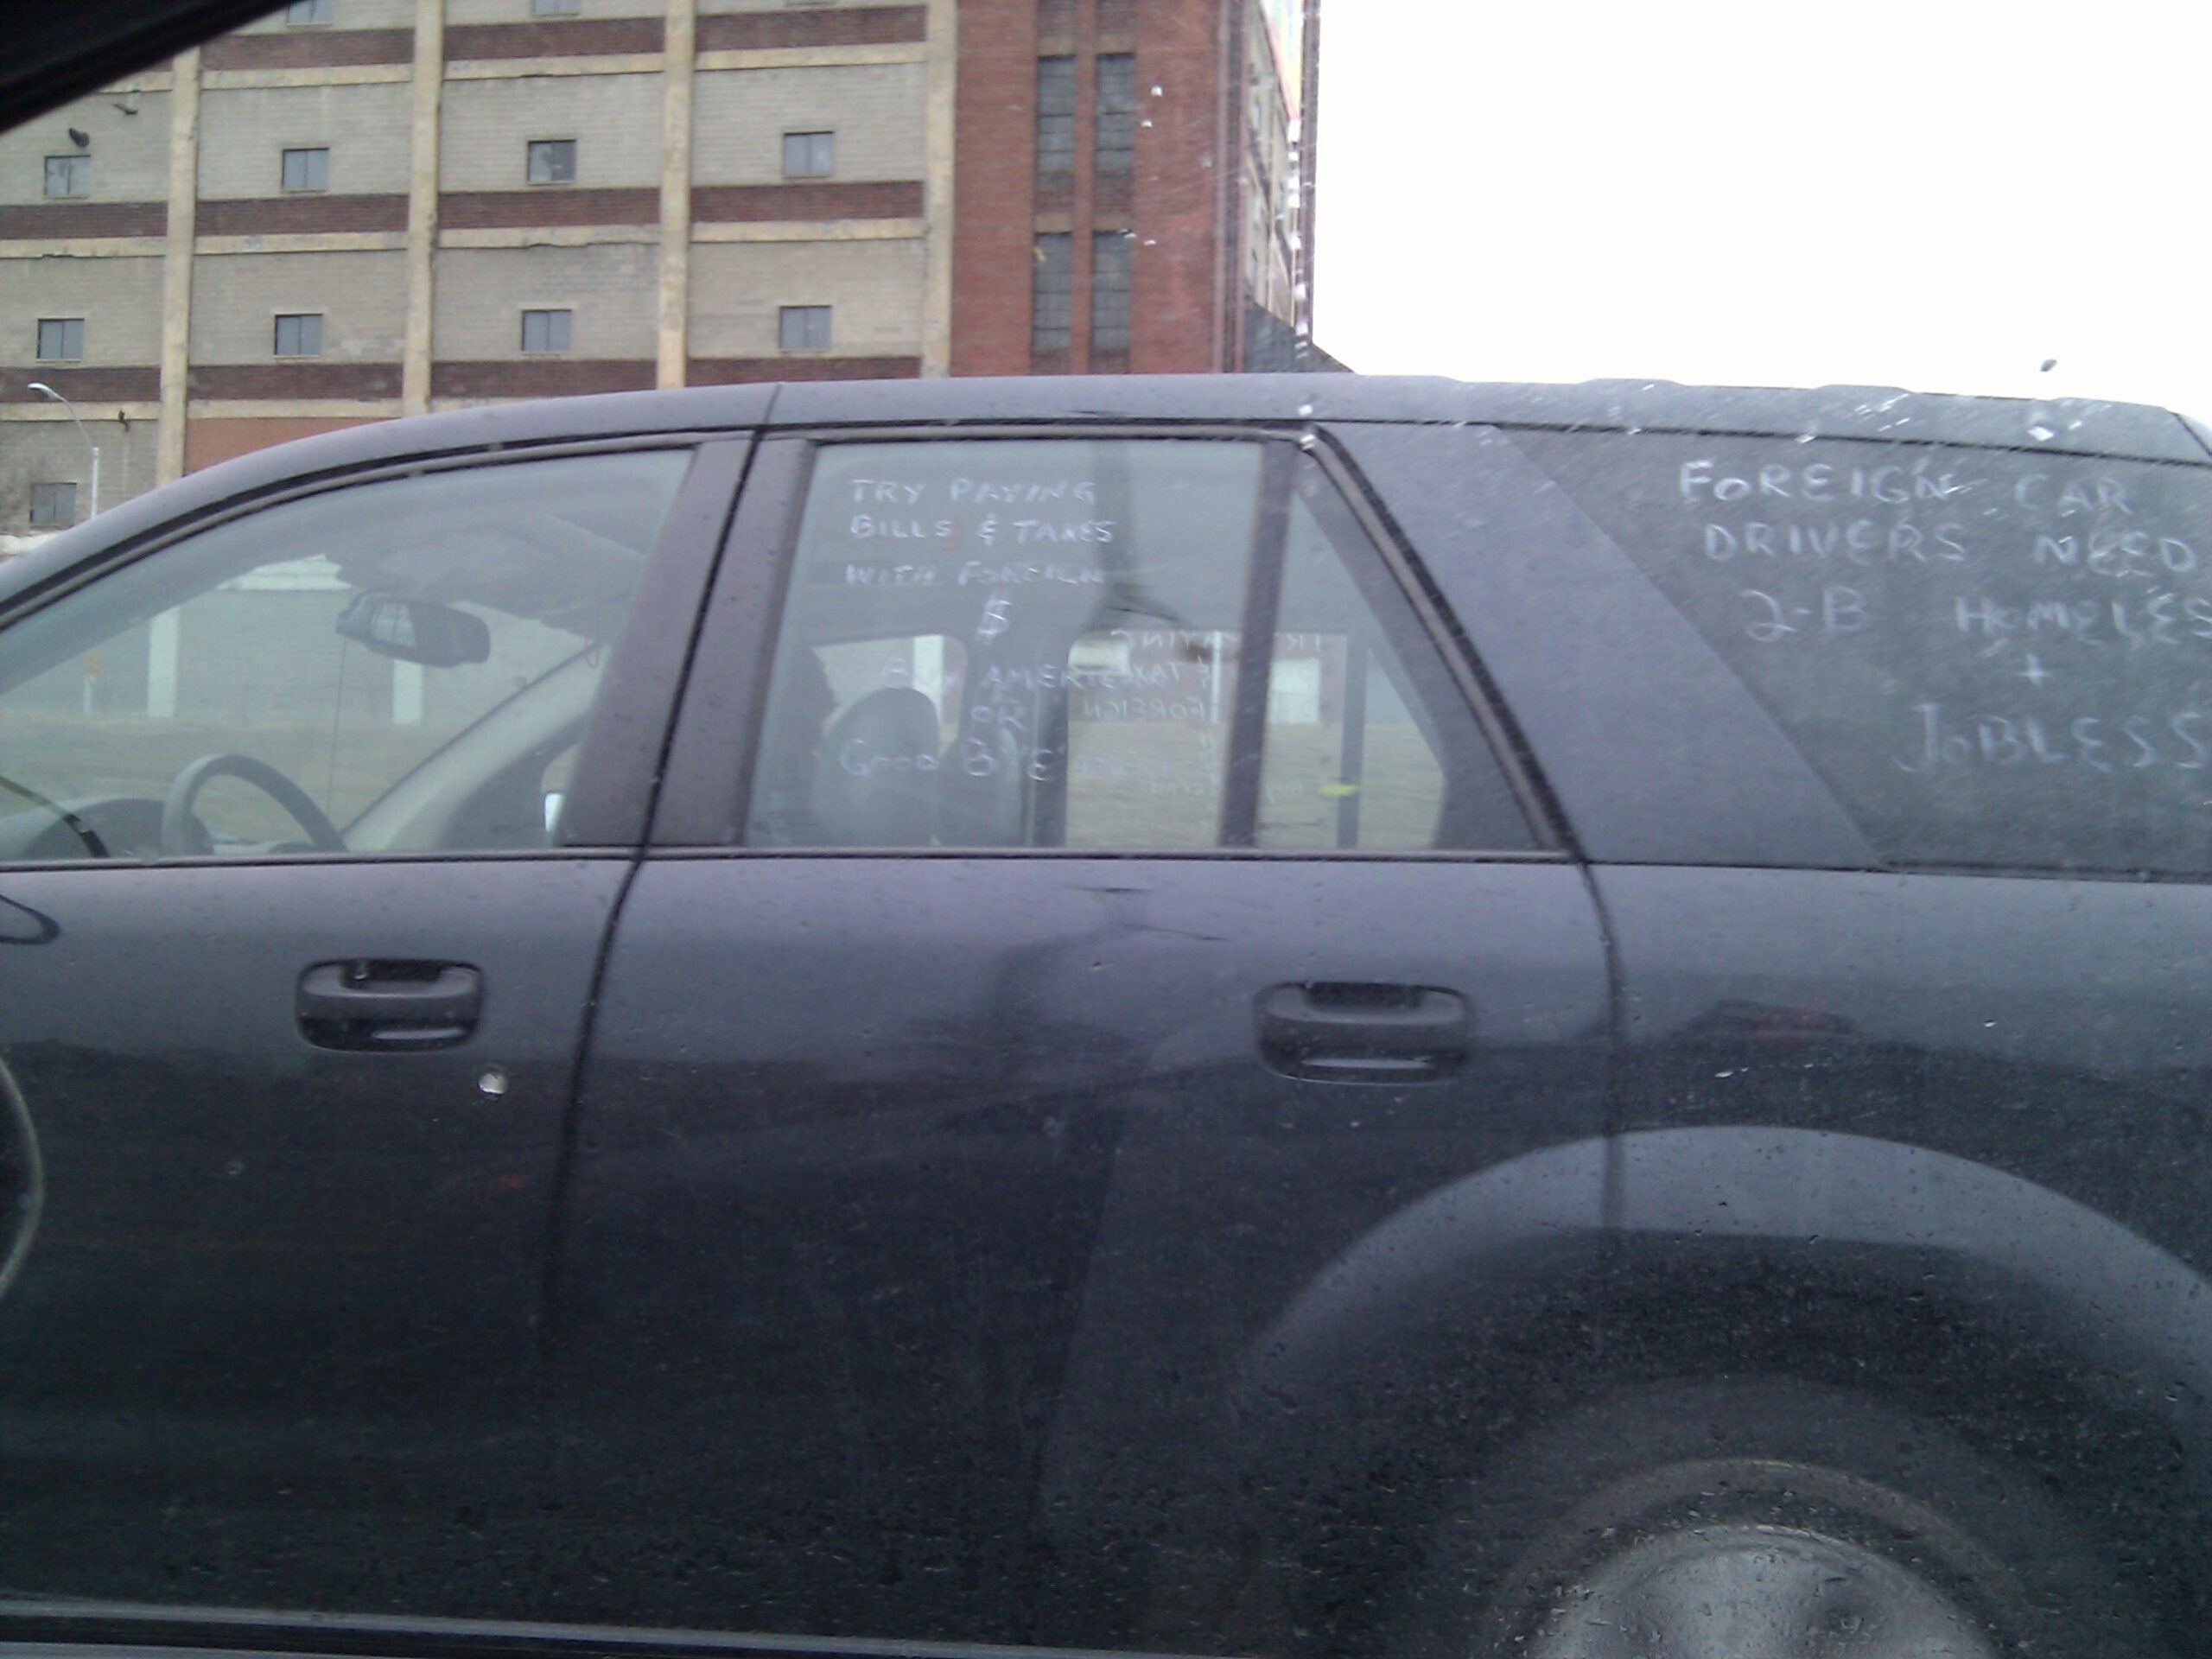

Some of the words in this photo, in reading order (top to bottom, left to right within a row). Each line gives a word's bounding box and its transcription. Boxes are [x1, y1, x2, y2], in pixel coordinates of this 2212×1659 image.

[848, 477, 926, 506] TRY
[950, 476, 1096, 506] PAYING
[1678, 458, 1957, 504] FOREIGN
[2014, 473, 2133, 516] CAR
[849, 513, 956, 540] BILLS
[1703, 518, 1968, 567] DRIVERS
[2033, 529, 2198, 577] NEED
[844, 563, 938, 587] WITH
[1892, 701, 2211, 775] JOBLESS
